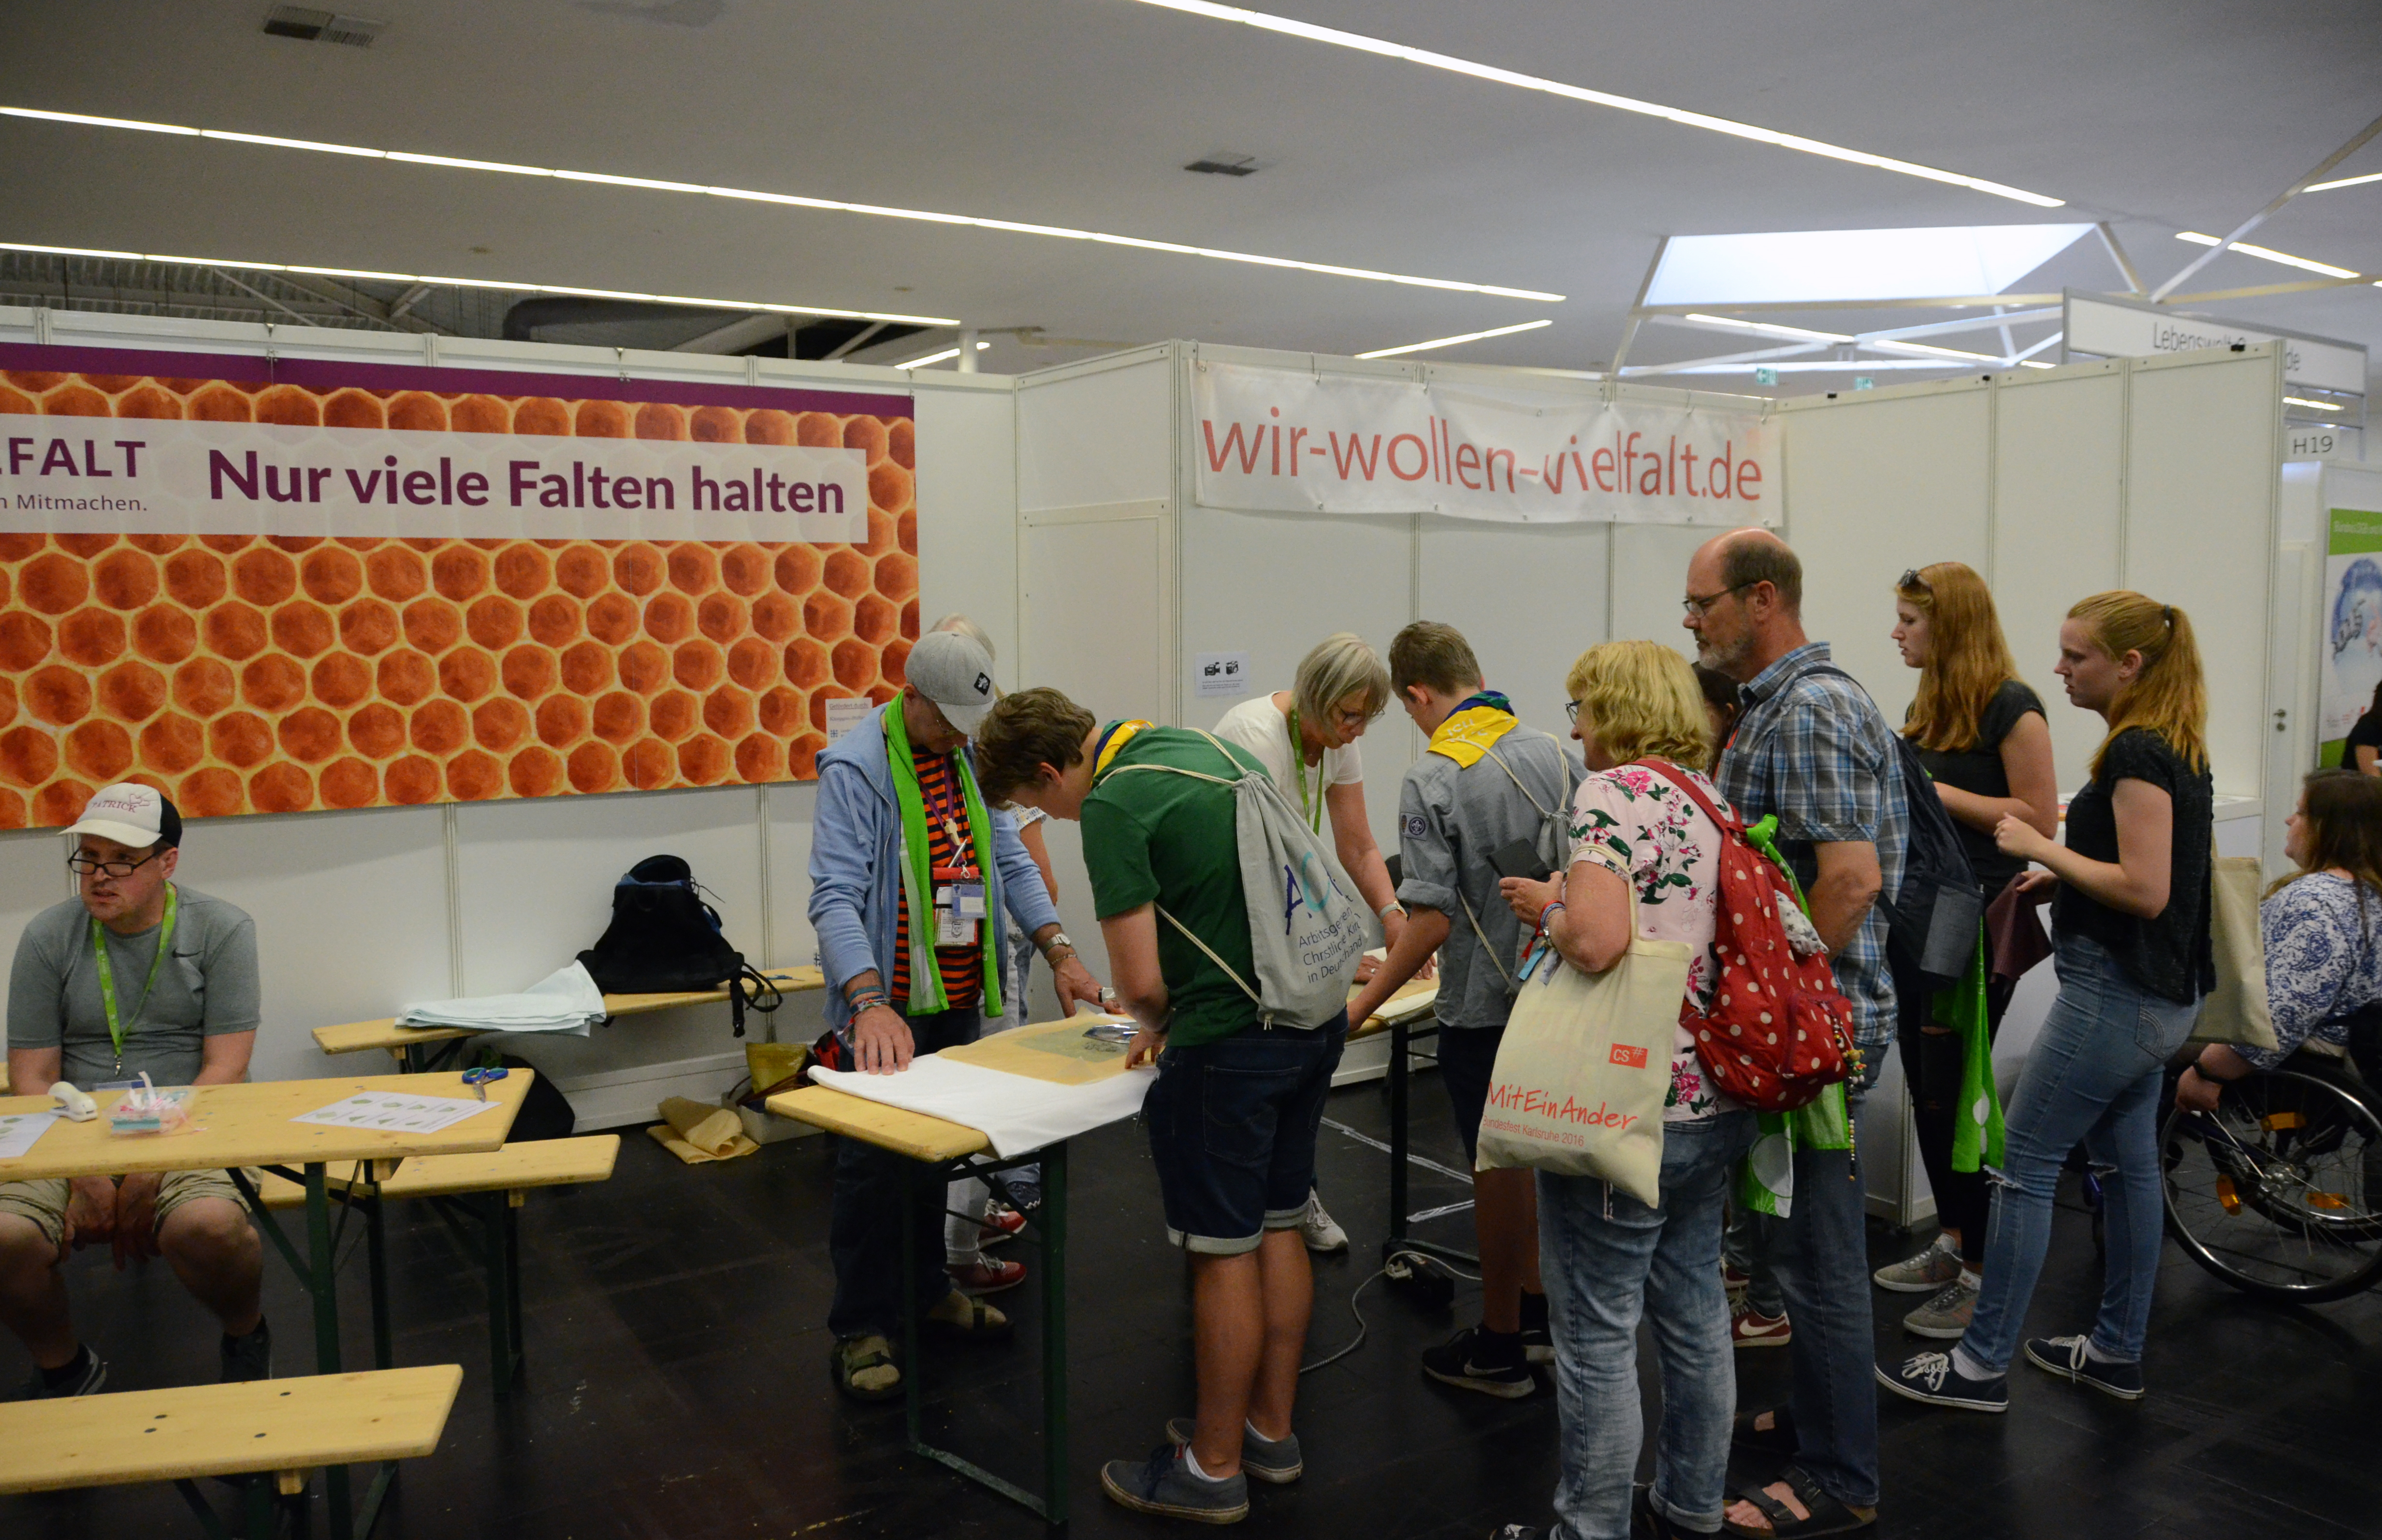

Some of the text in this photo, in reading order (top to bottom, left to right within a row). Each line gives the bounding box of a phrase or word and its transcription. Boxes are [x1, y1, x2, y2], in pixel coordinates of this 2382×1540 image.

[0, 437, 146, 477] FALT
[1202, 407, 1762, 500] wir-wollen-vielfalt.de
[2294, 436, 2333, 454] H19
[209, 449, 844, 514] Nur viele Falten halten
[17, 494, 147, 511] Mitmachen.
[1307, 972, 1318, 983] in
[1487, 1081, 1638, 1130] MitEinAnder
[1483, 1115, 1584, 1147] Bundesfest Karlsruhe 2016
